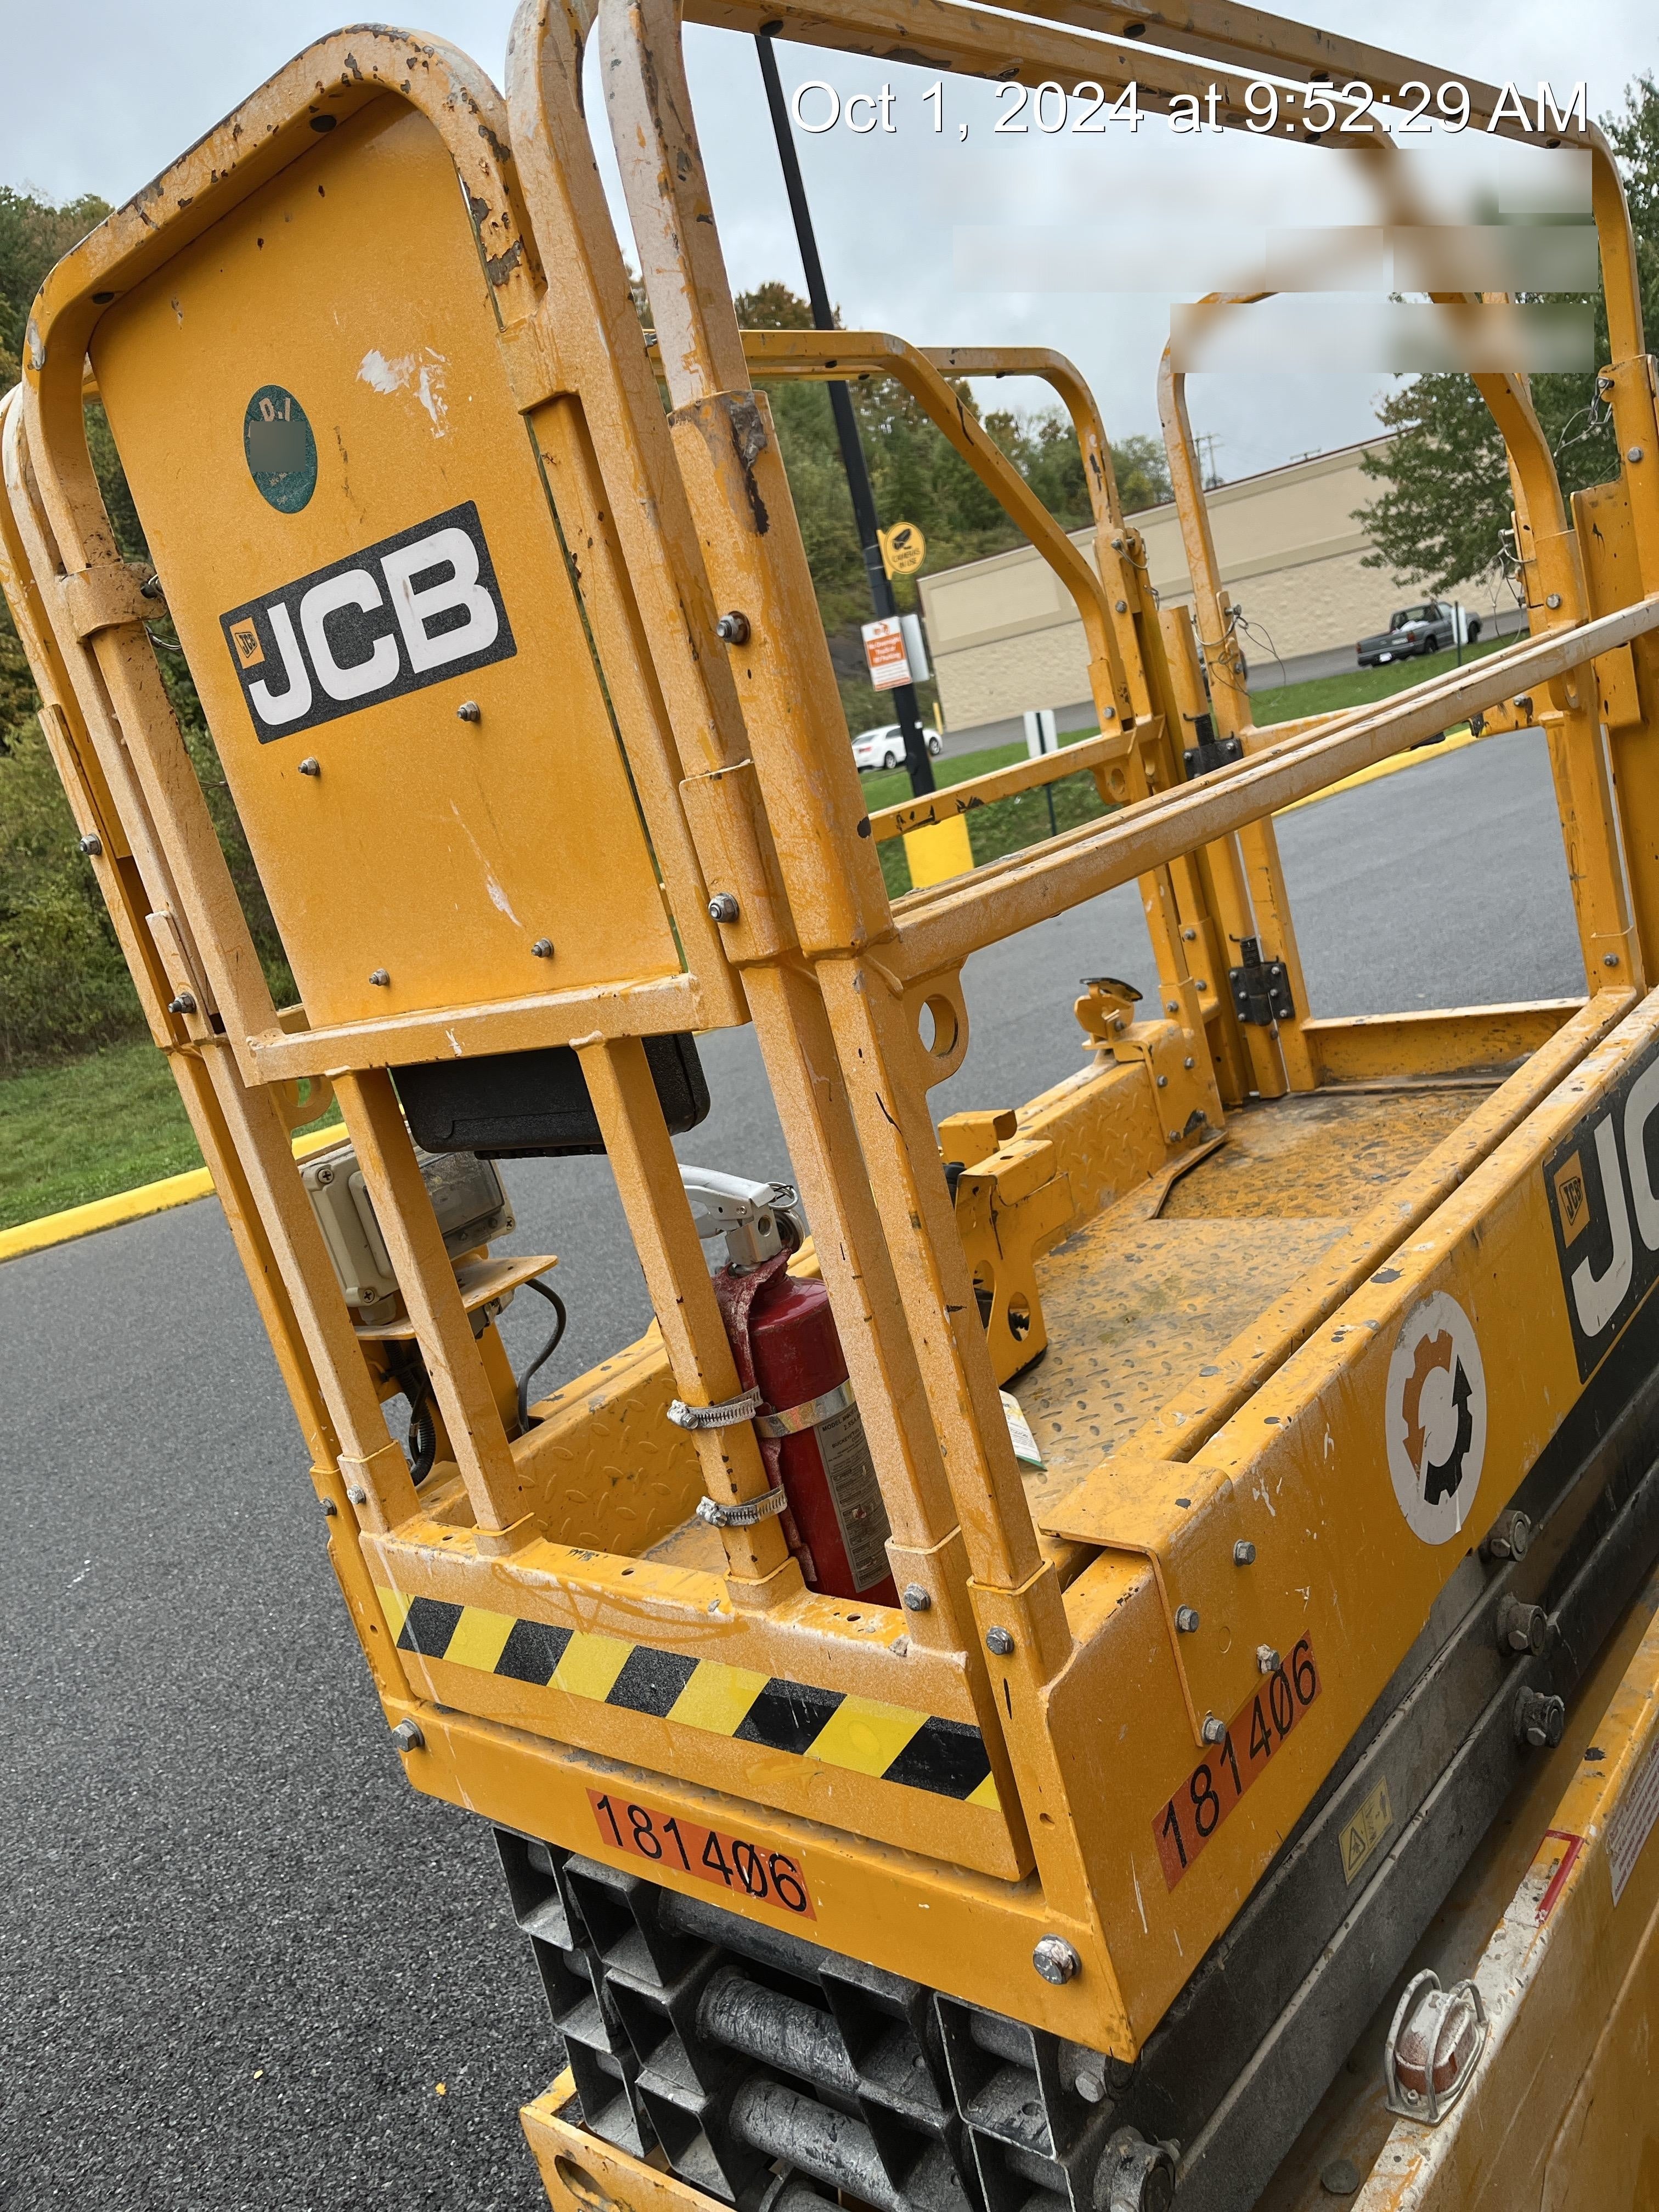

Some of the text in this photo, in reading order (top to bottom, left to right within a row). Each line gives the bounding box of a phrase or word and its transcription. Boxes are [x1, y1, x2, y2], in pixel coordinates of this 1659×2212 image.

[239, 634, 256, 655] JCB
[249, 528, 499, 725] JCB
[1563, 1180, 1582, 1219] JCB
[1162, 1640, 1316, 1869] 181406
[597, 1795, 807, 1912] 181406
